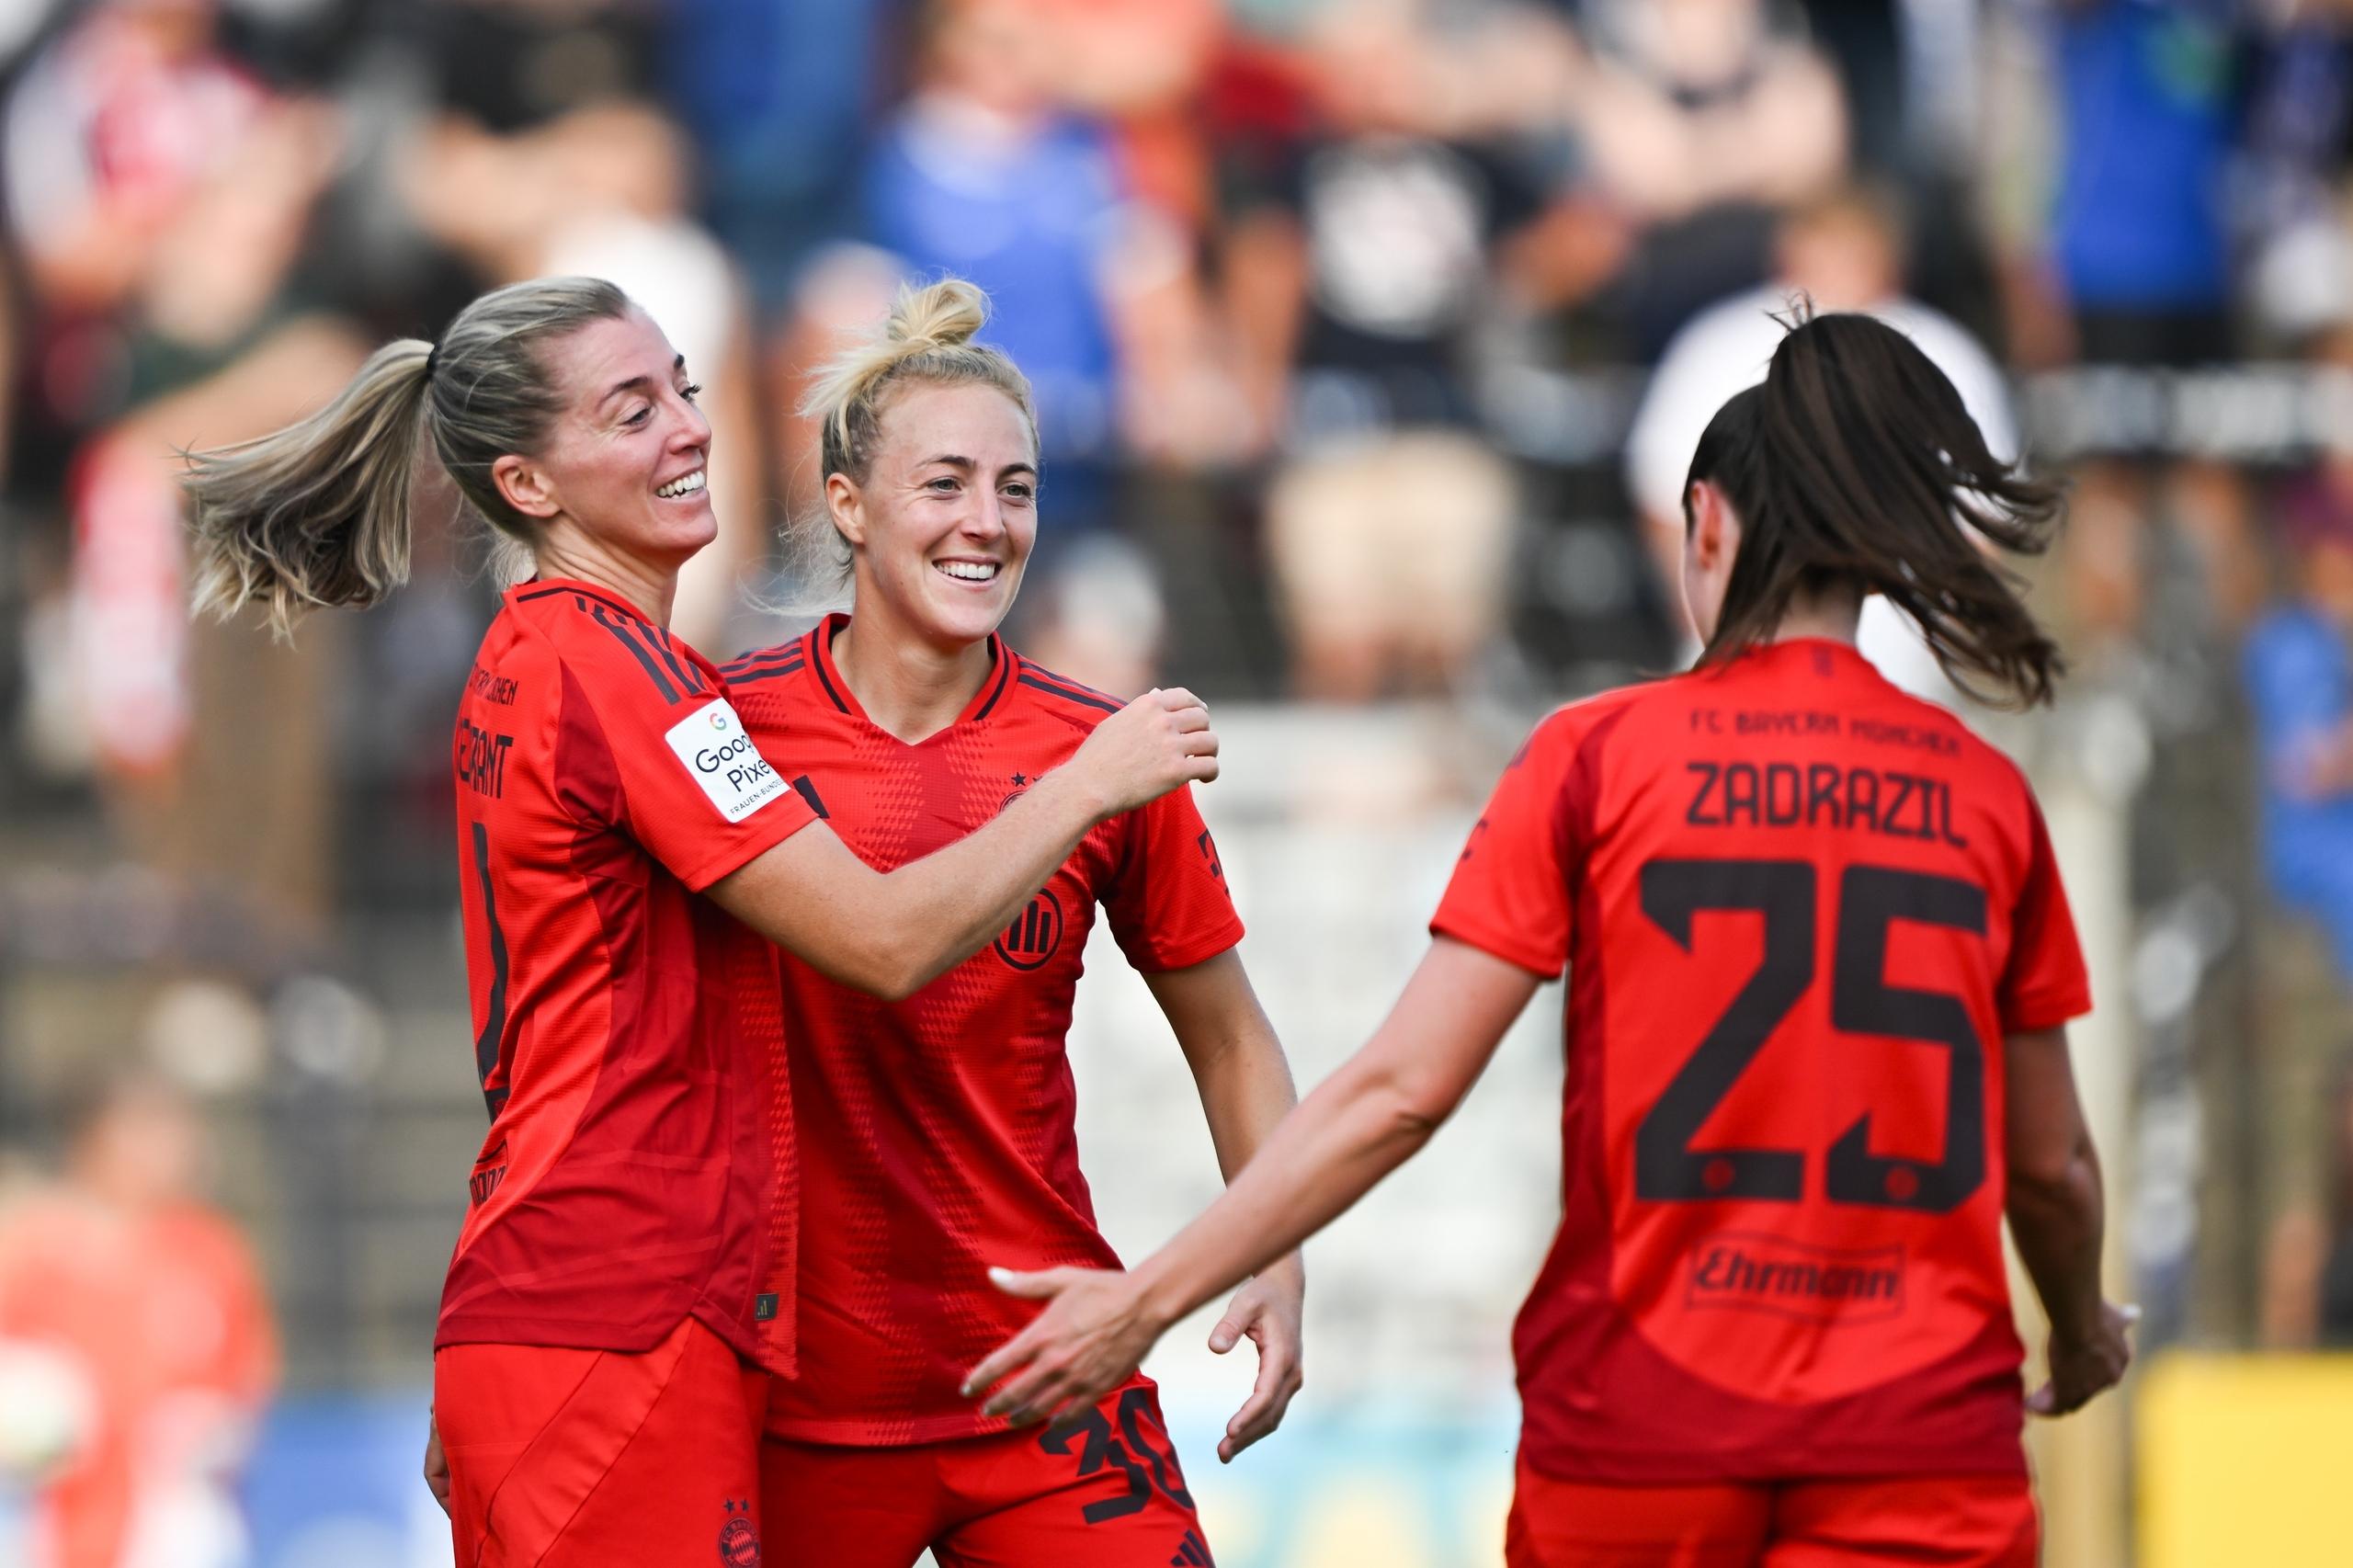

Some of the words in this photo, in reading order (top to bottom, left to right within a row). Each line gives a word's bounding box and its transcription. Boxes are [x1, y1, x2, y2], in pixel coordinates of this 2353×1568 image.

[709, 712, 728, 732] G
[1689, 709, 1723, 734] FC
[726, 758, 773, 793] Pixe
[1686, 762, 1968, 849] ZADRAZIL
[1633, 858, 1988, 1215] 25
[1696, 1246, 1899, 1301] Ehrmann
[1038, 1388, 1196, 1526] 30
